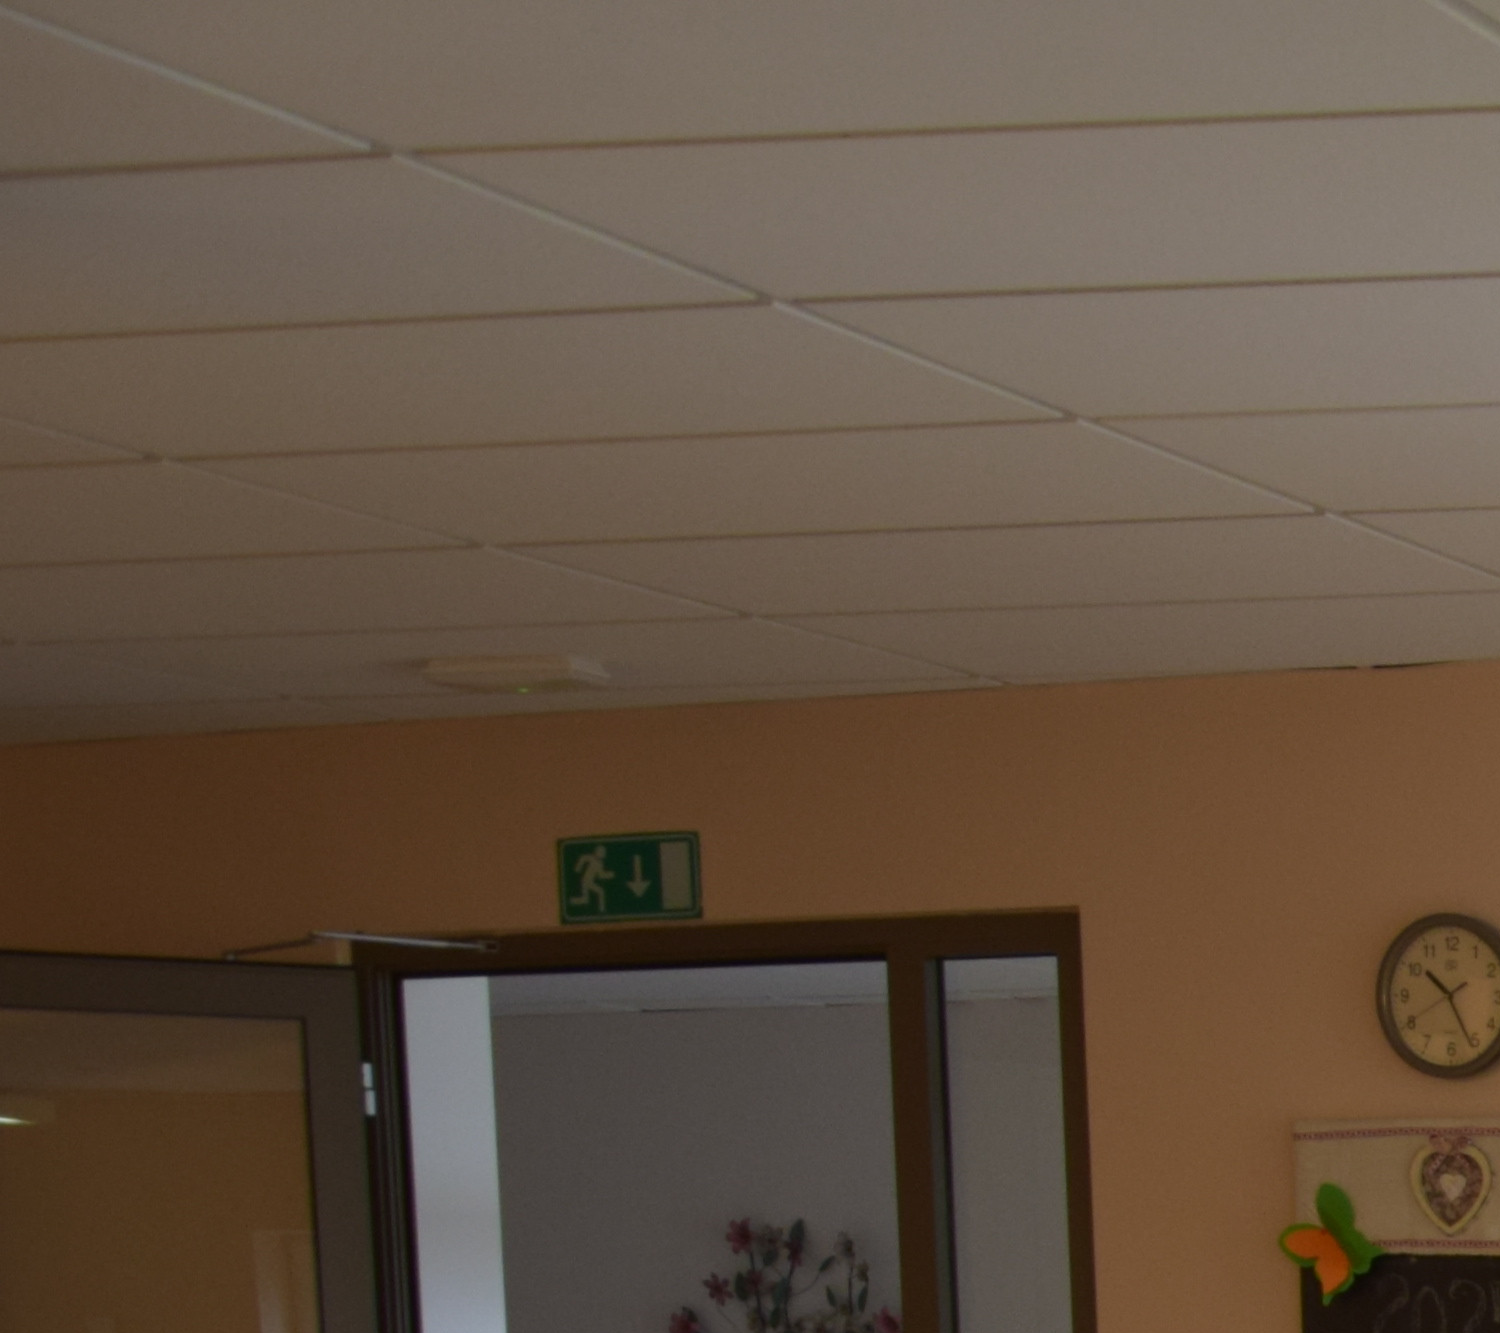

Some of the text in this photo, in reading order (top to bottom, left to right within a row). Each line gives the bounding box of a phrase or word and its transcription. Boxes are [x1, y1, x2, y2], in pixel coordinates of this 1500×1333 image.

[1445, 937, 1459, 951] 12
[1423, 945, 1436, 958] 11
[1408, 963, 1422, 976] 10
[1486, 963, 1497, 978] 2
[1400, 989, 1410, 1003] 9
[1406, 1015, 1416, 1030] 8
[1486, 1016, 1495, 1031] 4
[1423, 1034, 1432, 1049] 7
[1447, 1042, 1457, 1056] 6
